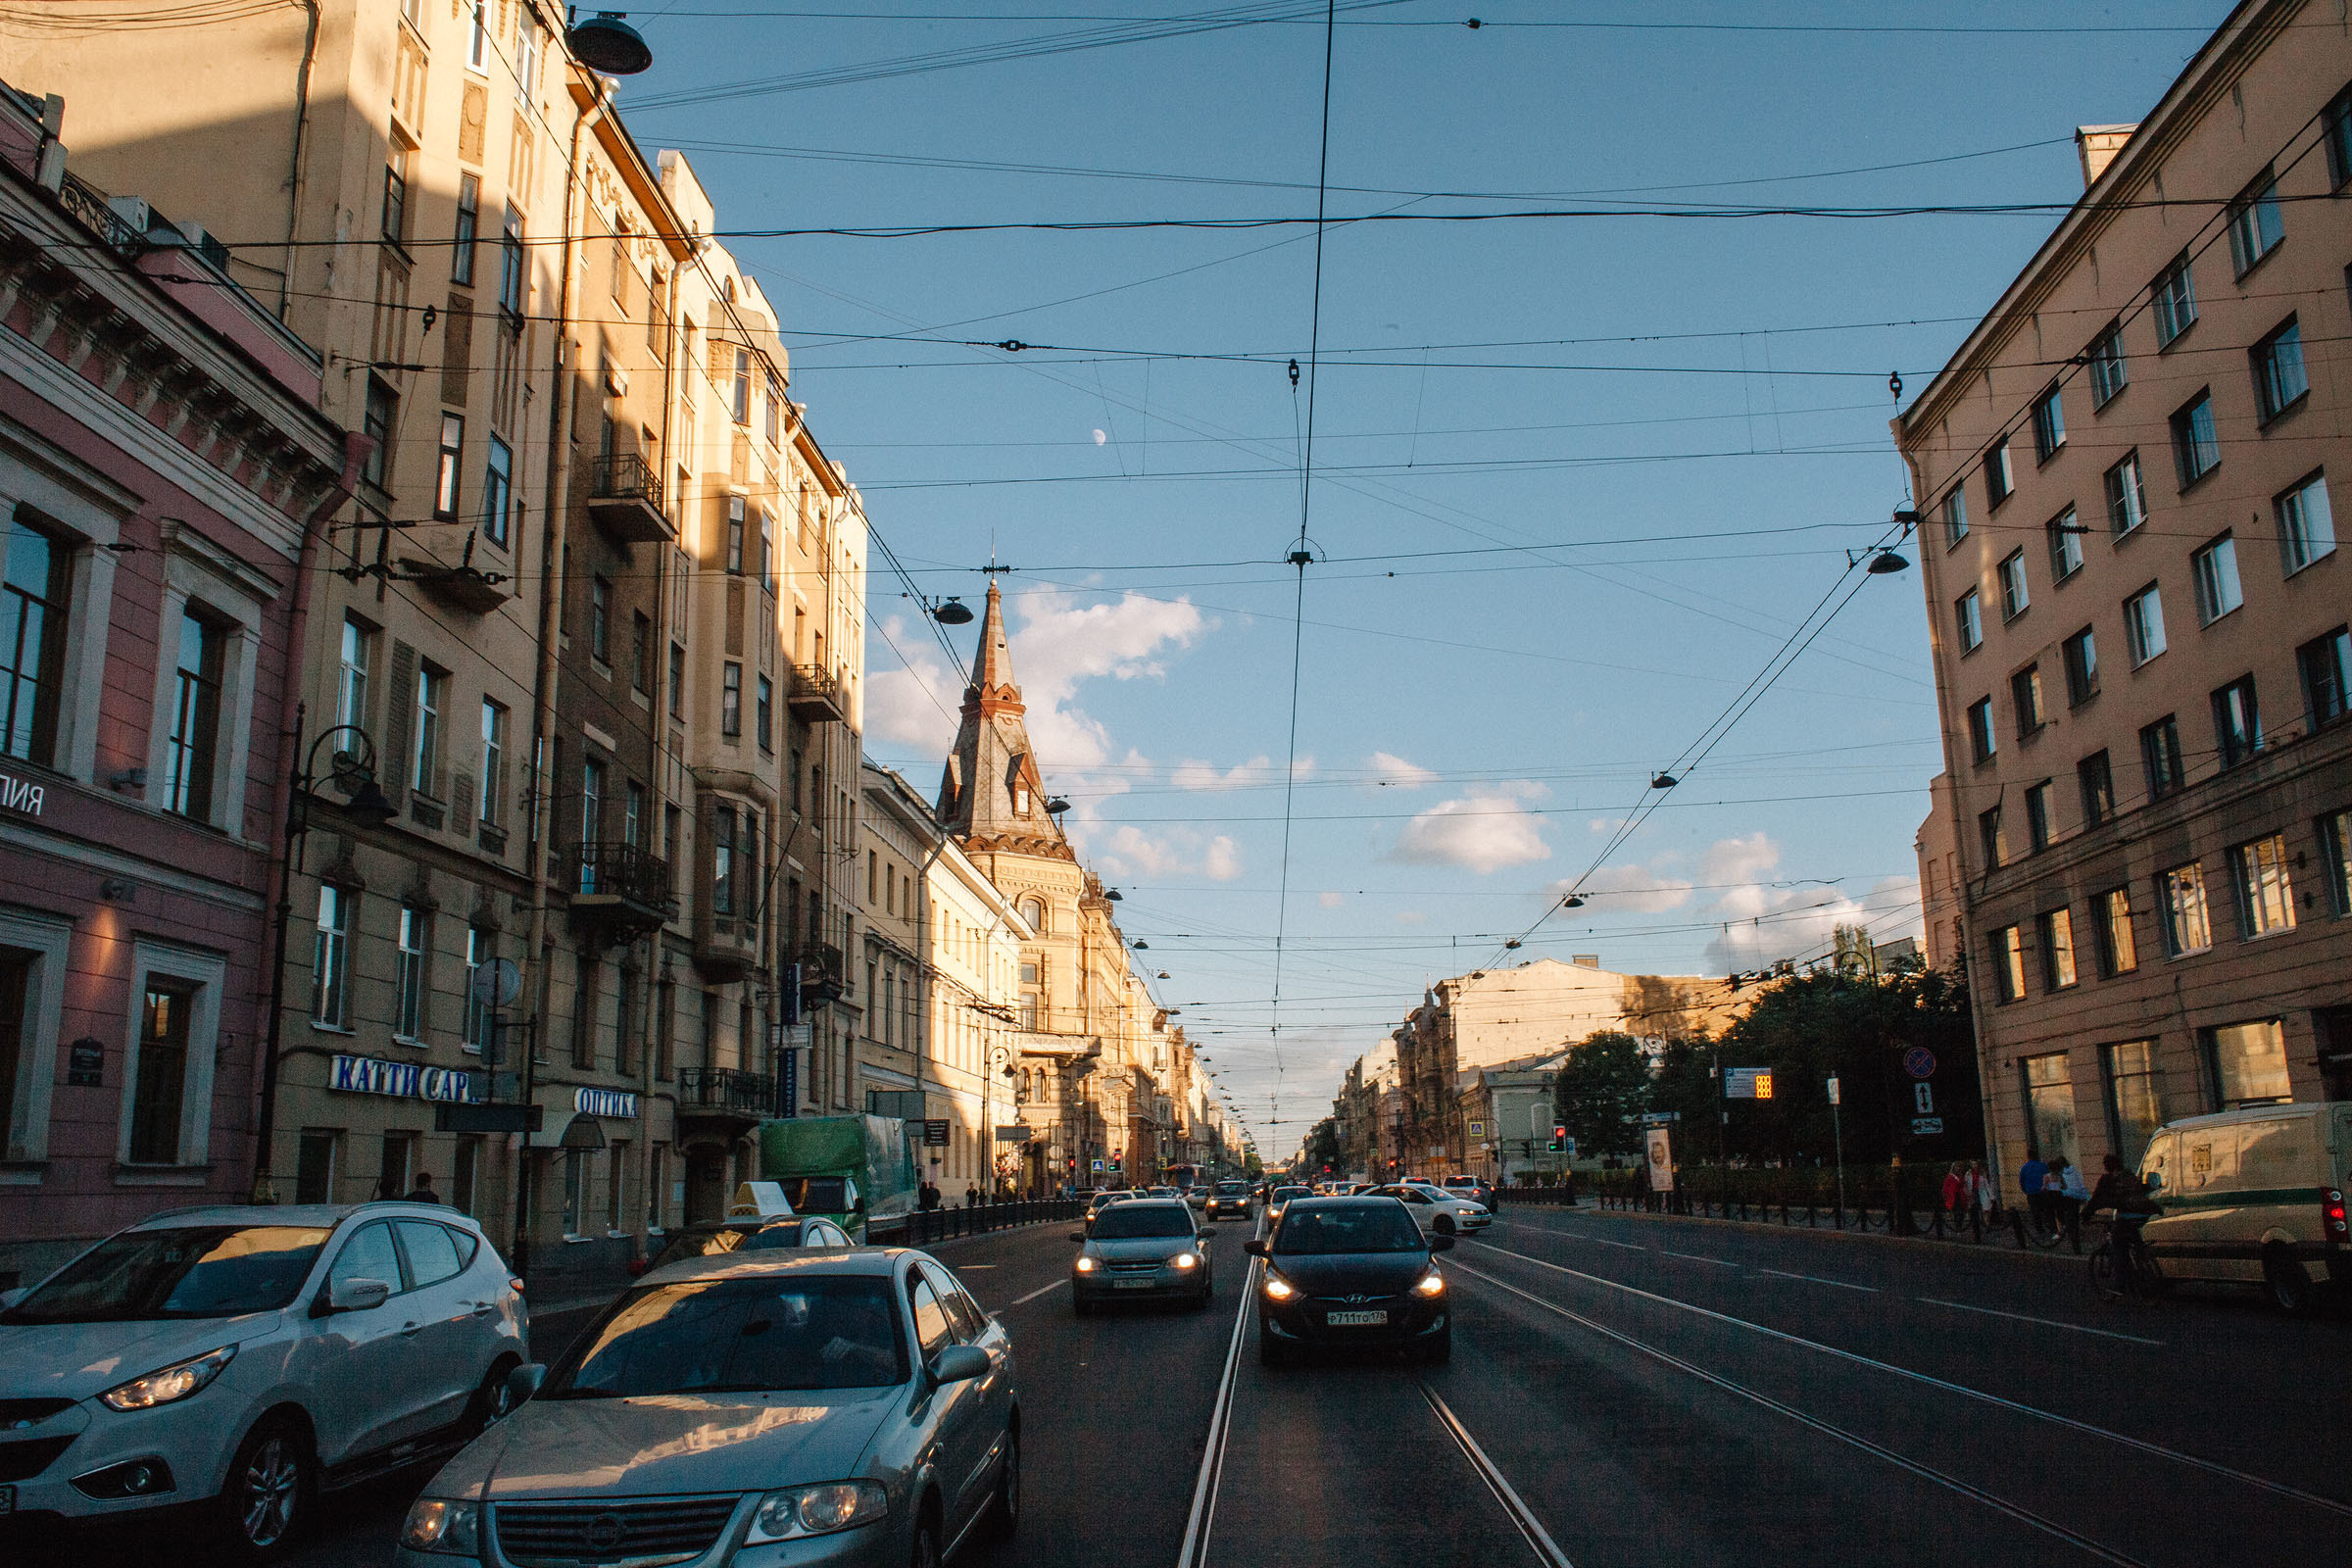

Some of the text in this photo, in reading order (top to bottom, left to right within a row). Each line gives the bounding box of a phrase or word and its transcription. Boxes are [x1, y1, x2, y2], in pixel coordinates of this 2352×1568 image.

[337, 1055, 479, 1102] КАТТИ САР
[579, 1088, 636, 1117] ОПТИКА
